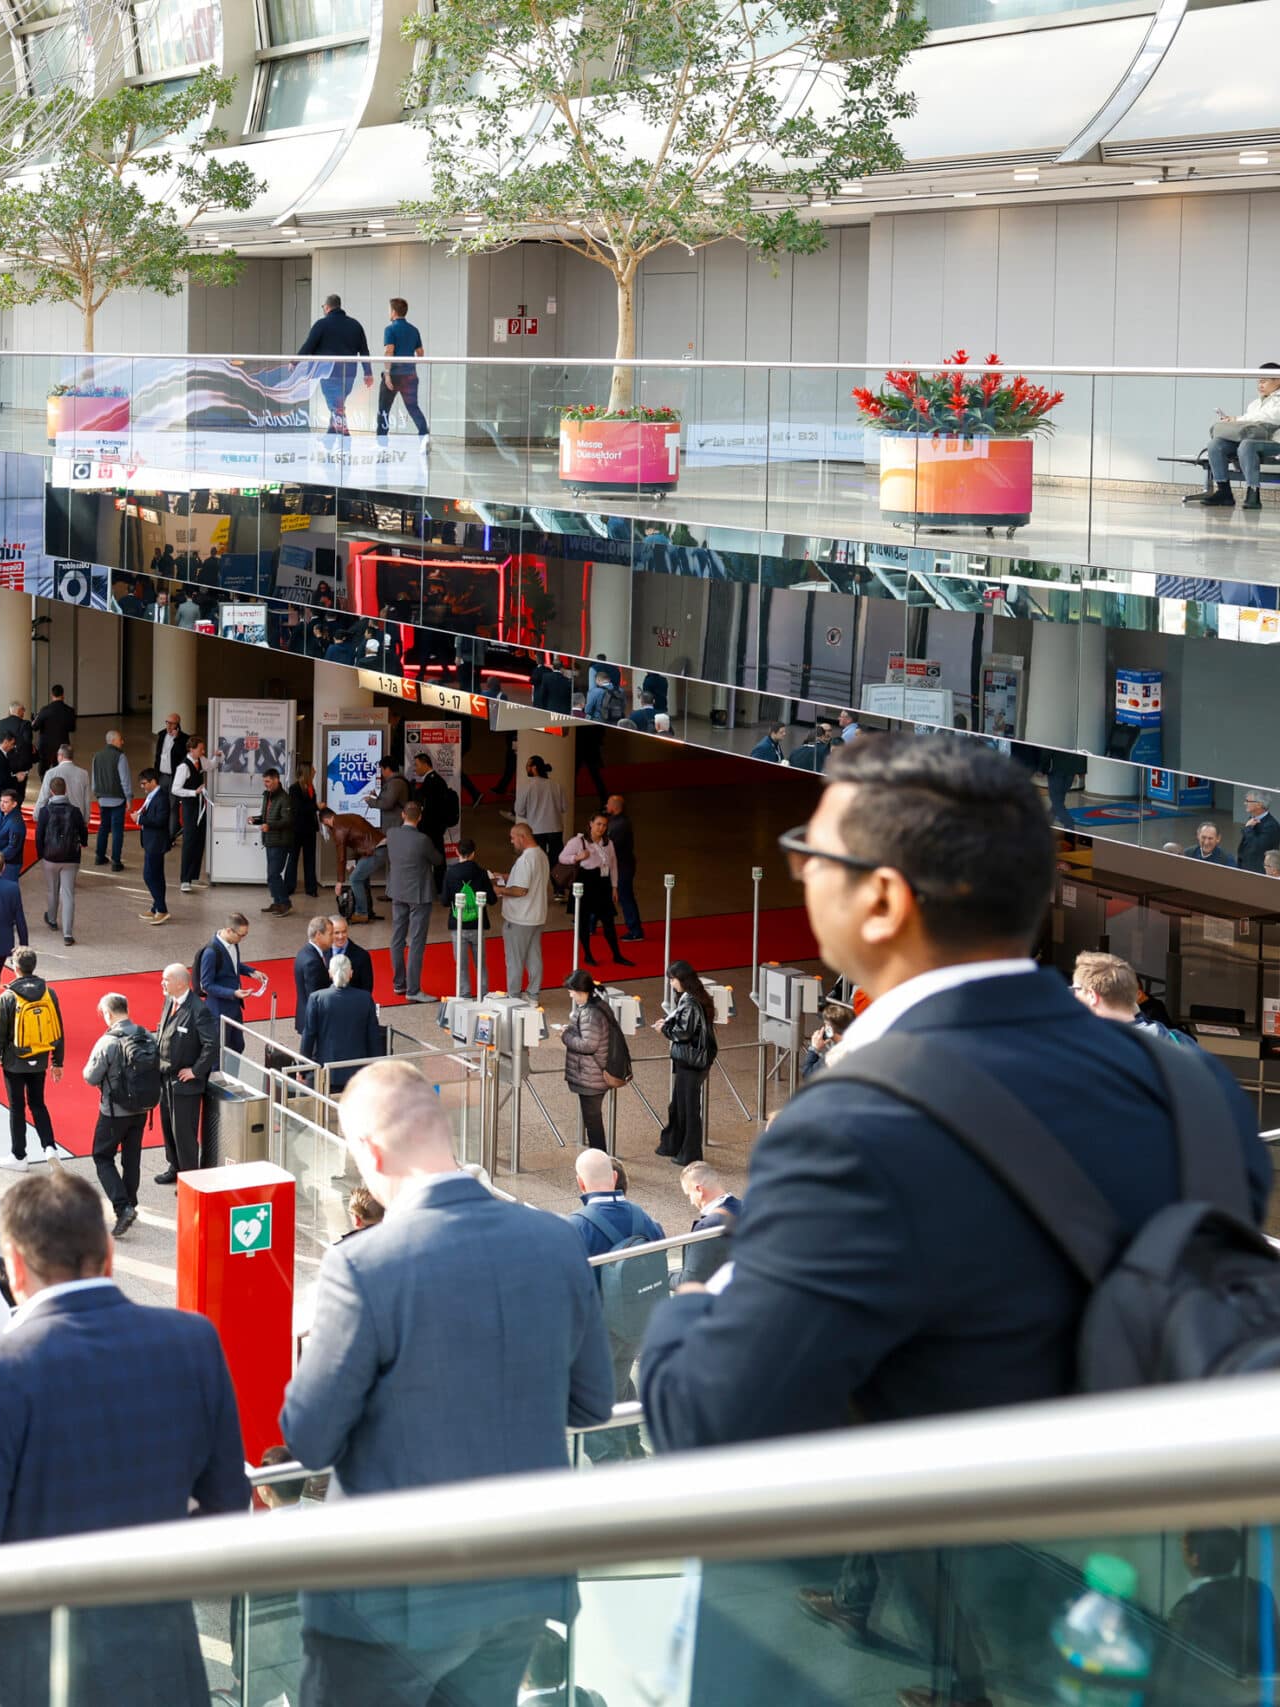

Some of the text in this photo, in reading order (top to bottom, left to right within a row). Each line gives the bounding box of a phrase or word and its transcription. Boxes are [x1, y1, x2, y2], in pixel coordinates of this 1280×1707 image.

[577, 440, 603, 449] Messe
[577, 449, 622, 460] Düsseldorf
[379, 676, 398, 694] 1-7a
[340, 753, 367, 762] HIGH
[339, 772, 373, 781] TIALS
